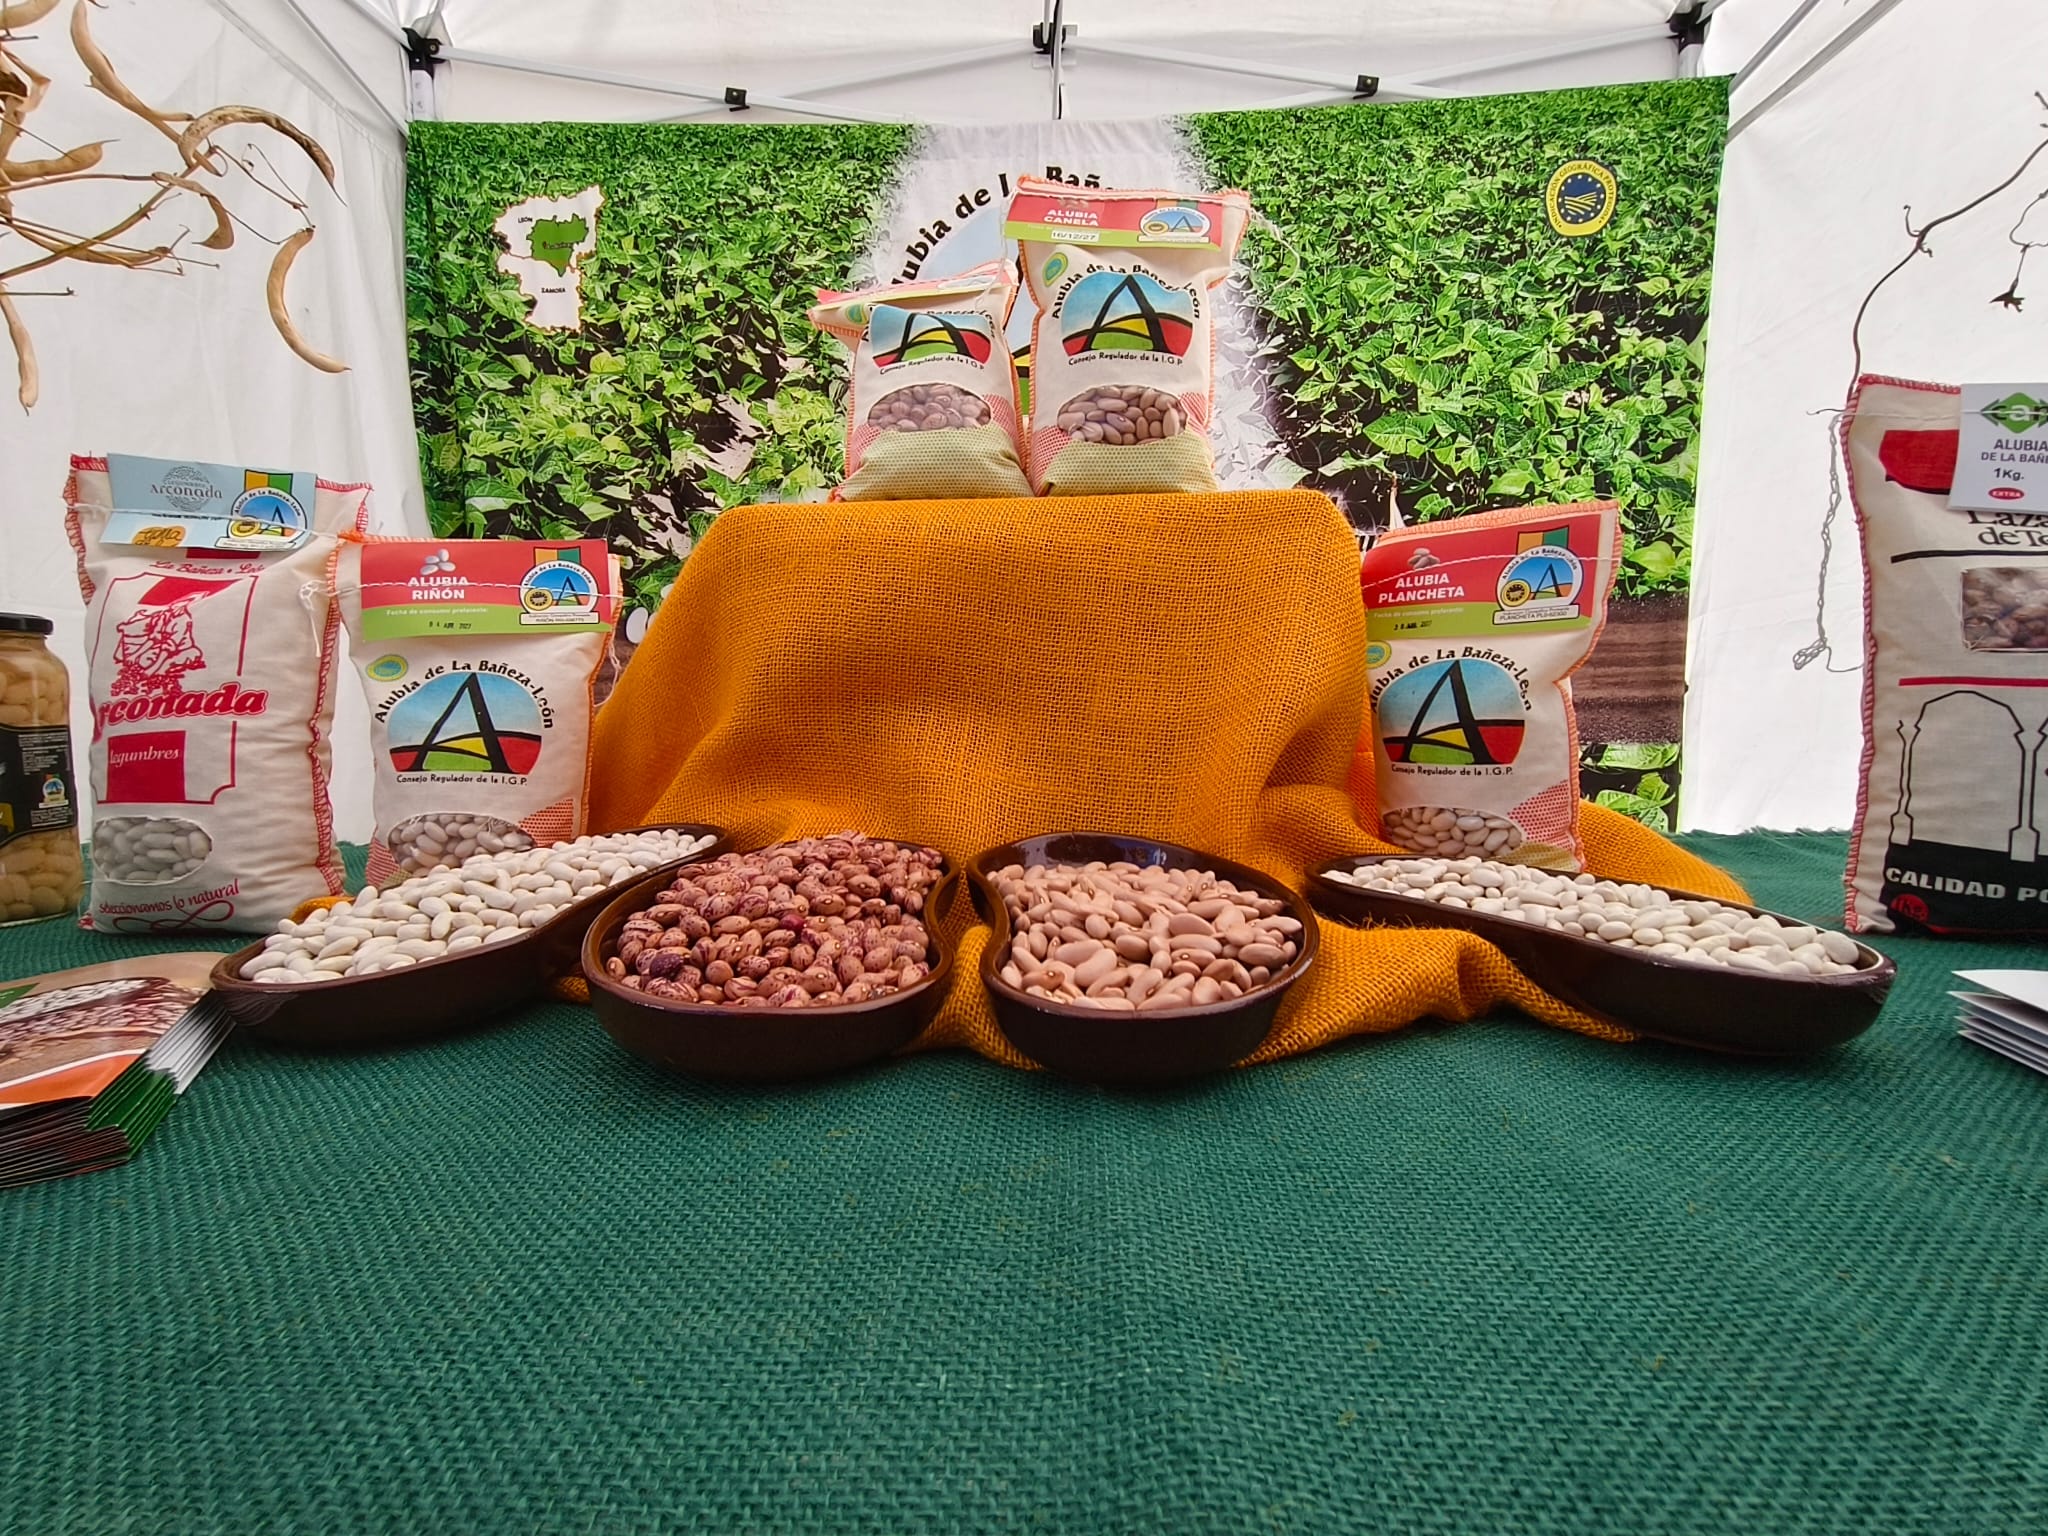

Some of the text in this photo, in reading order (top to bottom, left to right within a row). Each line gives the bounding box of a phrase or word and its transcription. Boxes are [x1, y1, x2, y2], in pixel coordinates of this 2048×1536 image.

[954, 188, 991, 219] de
[1044, 216, 1099, 226] CANELA
[1047, 209, 1098, 219] ALUBIA
[1052, 231, 1096, 240] 16/12/27
[1051, 273, 1083, 319] Alubia
[1086, 263, 1105, 274] de
[1109, 265, 1127, 274] La
[908, 356, 944, 367] Regulador
[1068, 354, 1097, 366] Consejo
[1099, 351, 1138, 361] Regulador
[1139, 353, 1150, 361] de
[1152, 353, 1159, 362] la
[1981, 451, 1996, 461] DE
[2000, 453, 2016, 462] LA
[150, 483, 223, 500] Arconada
[149, 560, 175, 569] La
[176, 563, 224, 575] Bañeza
[1502, 560, 1519, 580] Alubia
[407, 576, 469, 587] ALUBIA
[1395, 573, 1450, 589] ALUBIA
[412, 587, 465, 600] RIÑÓN
[1378, 586, 1465, 603] PLANCHETA
[386, 609, 407, 617] Fecha
[419, 608, 450, 616] consumo
[1402, 609, 1430, 617] consumo
[1408, 654, 1430, 669] de
[1436, 648, 1455, 660] La
[1461, 646, 1533, 712] Bañeza-León
[374, 659, 554, 729] Alubia de La Bañeza-León
[97, 681, 268, 729] rconada
[109, 746, 179, 768] legumbres
[1391, 764, 1416, 774] Consejo
[1417, 765, 1457, 776] Regulador
[1459, 766, 1472, 775] de
[1474, 766, 1482, 775] la
[396, 774, 428, 783] Consejo
[430, 774, 474, 784] Regulador
[476, 774, 488, 784] de
[490, 775, 498, 784] la
[1885, 866, 2006, 899] CALIDAD
[173, 895, 185, 911] lo
[188, 878, 240, 906] natural
